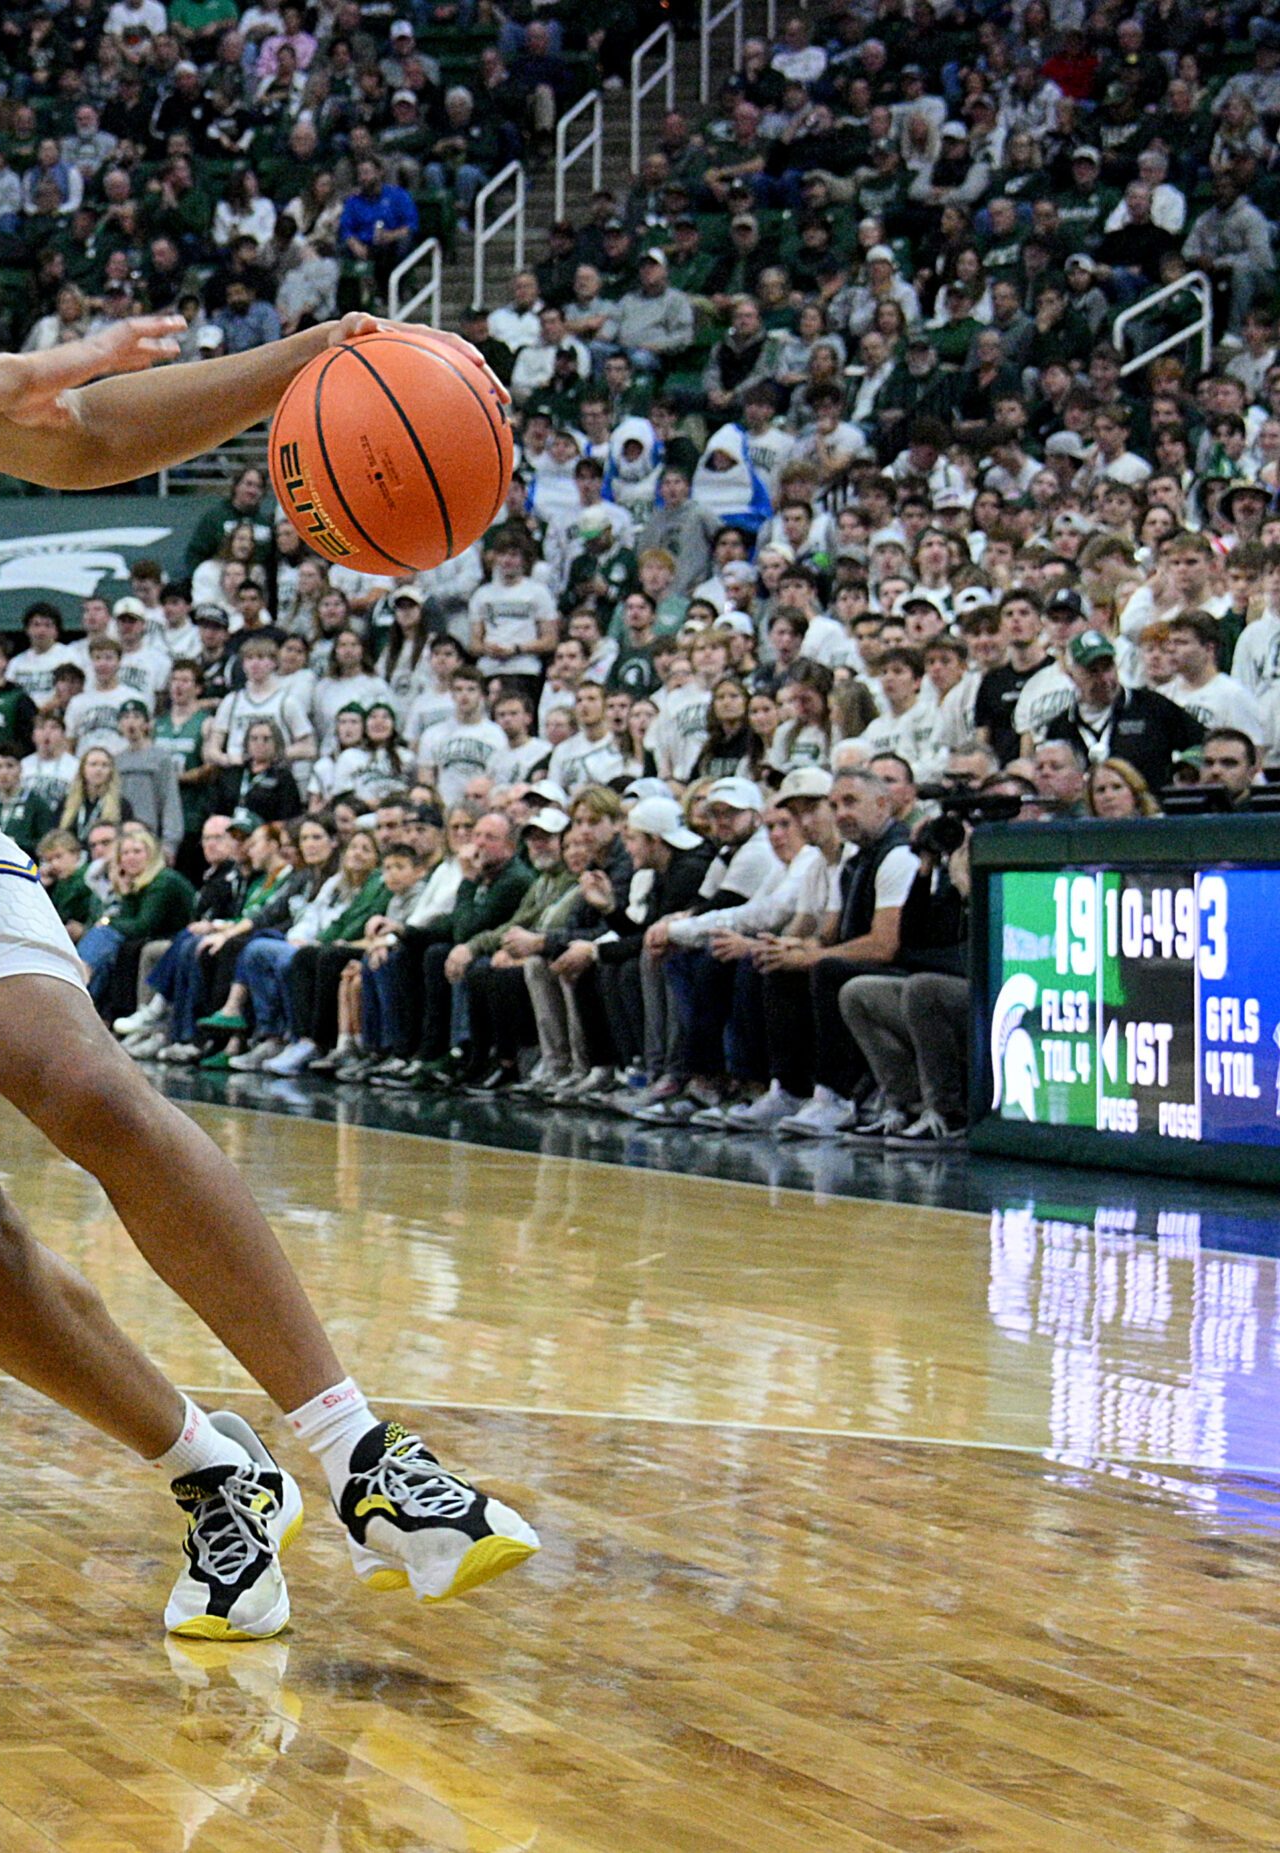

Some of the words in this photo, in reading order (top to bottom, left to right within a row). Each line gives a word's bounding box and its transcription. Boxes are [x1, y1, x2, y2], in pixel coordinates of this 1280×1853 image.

[280, 441, 352, 556] ELITE
[1053, 876, 1096, 975] 19
[1105, 888, 1195, 959] 10:49
[1199, 876, 1227, 979] 3
[1125, 1022, 1173, 1087] 1ST
